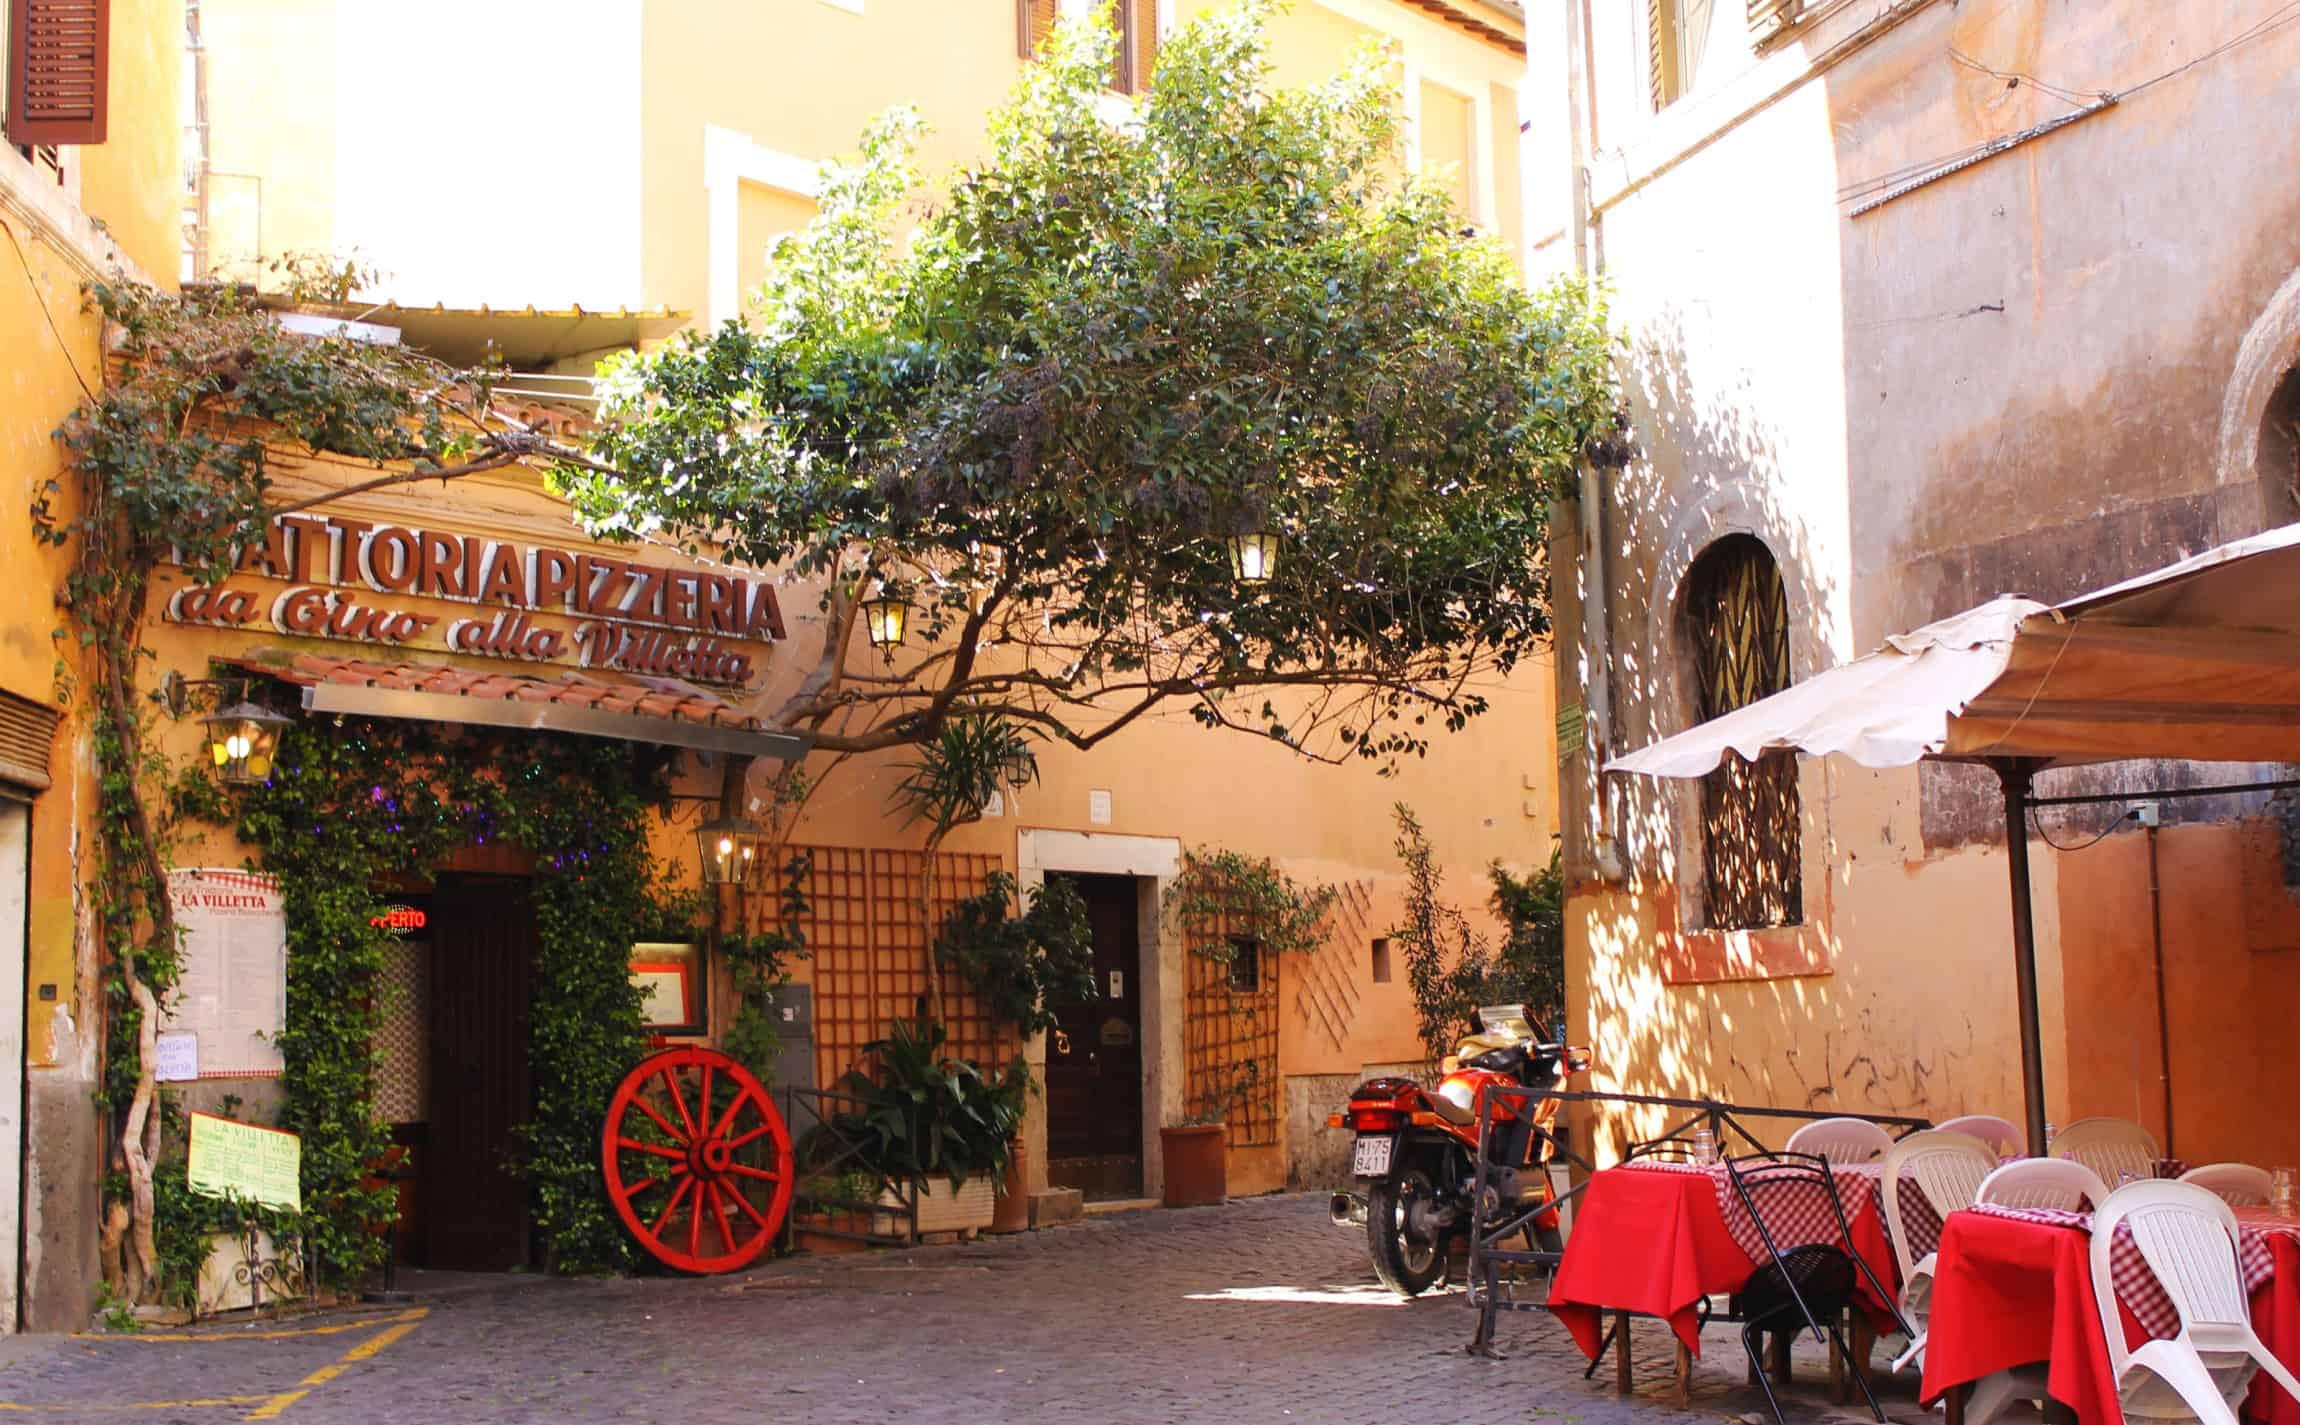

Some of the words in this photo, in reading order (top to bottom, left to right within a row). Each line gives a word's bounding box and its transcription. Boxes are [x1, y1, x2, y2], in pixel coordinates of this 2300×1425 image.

[150, 512, 530, 606] ATTORIA
[532, 547, 787, 641] PIZZERIA
[168, 580, 262, 625] da
[272, 586, 440, 645] Gino
[445, 612, 567, 663] alla
[574, 621, 754, 682] Villetta
[181, 894, 200, 908] LA
[202, 894, 267, 909] VILLETTA
